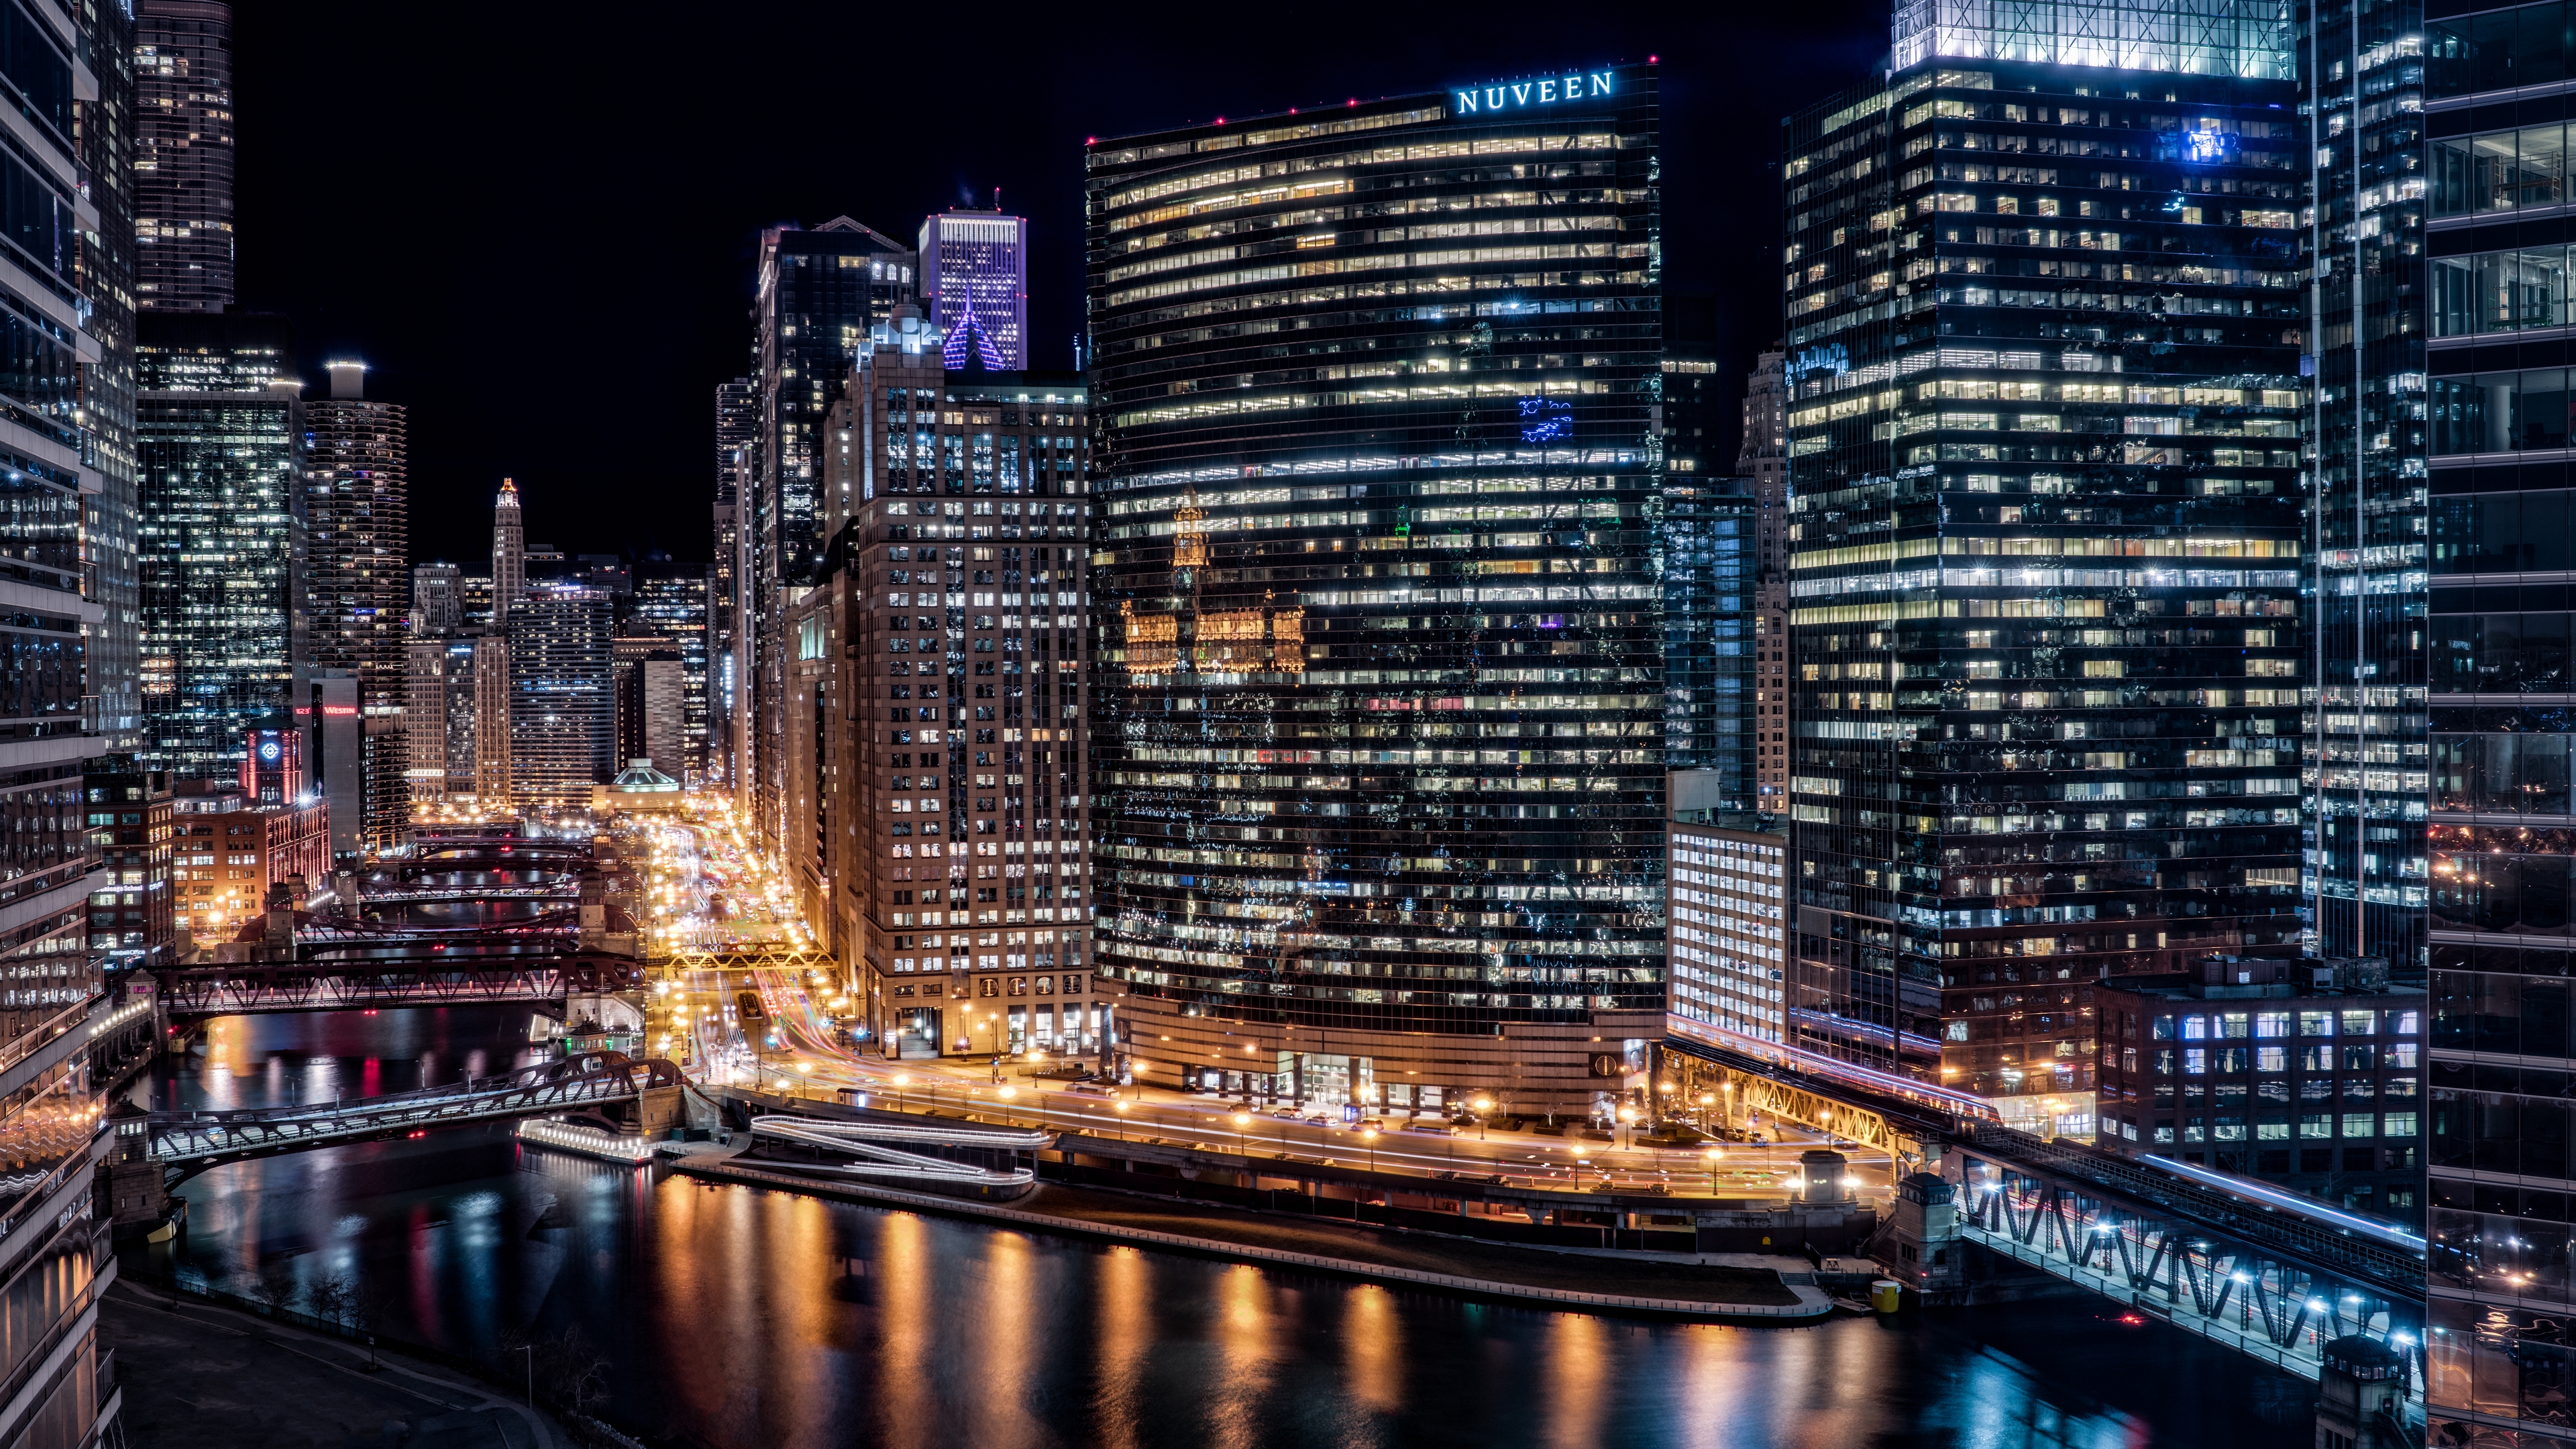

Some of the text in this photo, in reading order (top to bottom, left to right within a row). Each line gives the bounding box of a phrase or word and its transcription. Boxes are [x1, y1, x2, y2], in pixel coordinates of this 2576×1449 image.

[1458, 72, 1613, 114] NUVEEN
[2141, 1301, 2167, 1315] LAKE STREET
